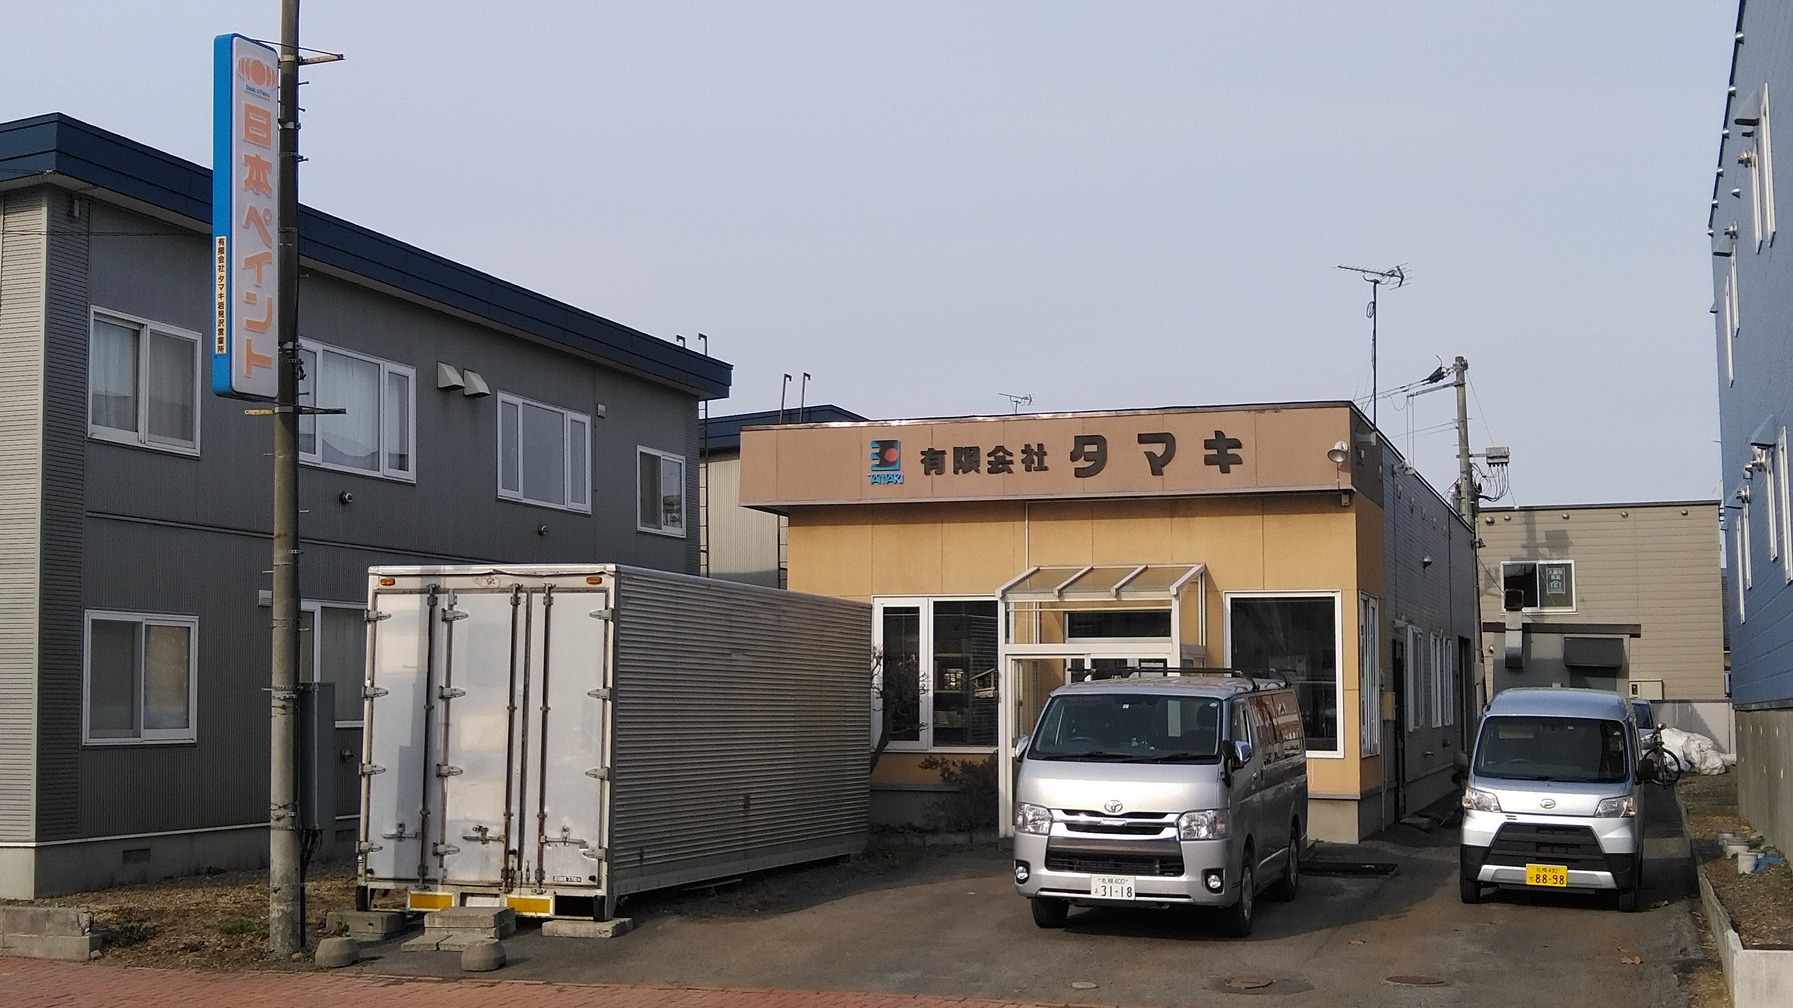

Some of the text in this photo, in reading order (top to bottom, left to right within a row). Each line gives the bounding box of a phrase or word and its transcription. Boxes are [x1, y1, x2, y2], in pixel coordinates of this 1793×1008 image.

[243, 102, 272, 377] 日本ペイント
[1535, 873, 1565, 885] 88-98
[1101, 885, 1133, 898] 31-18
